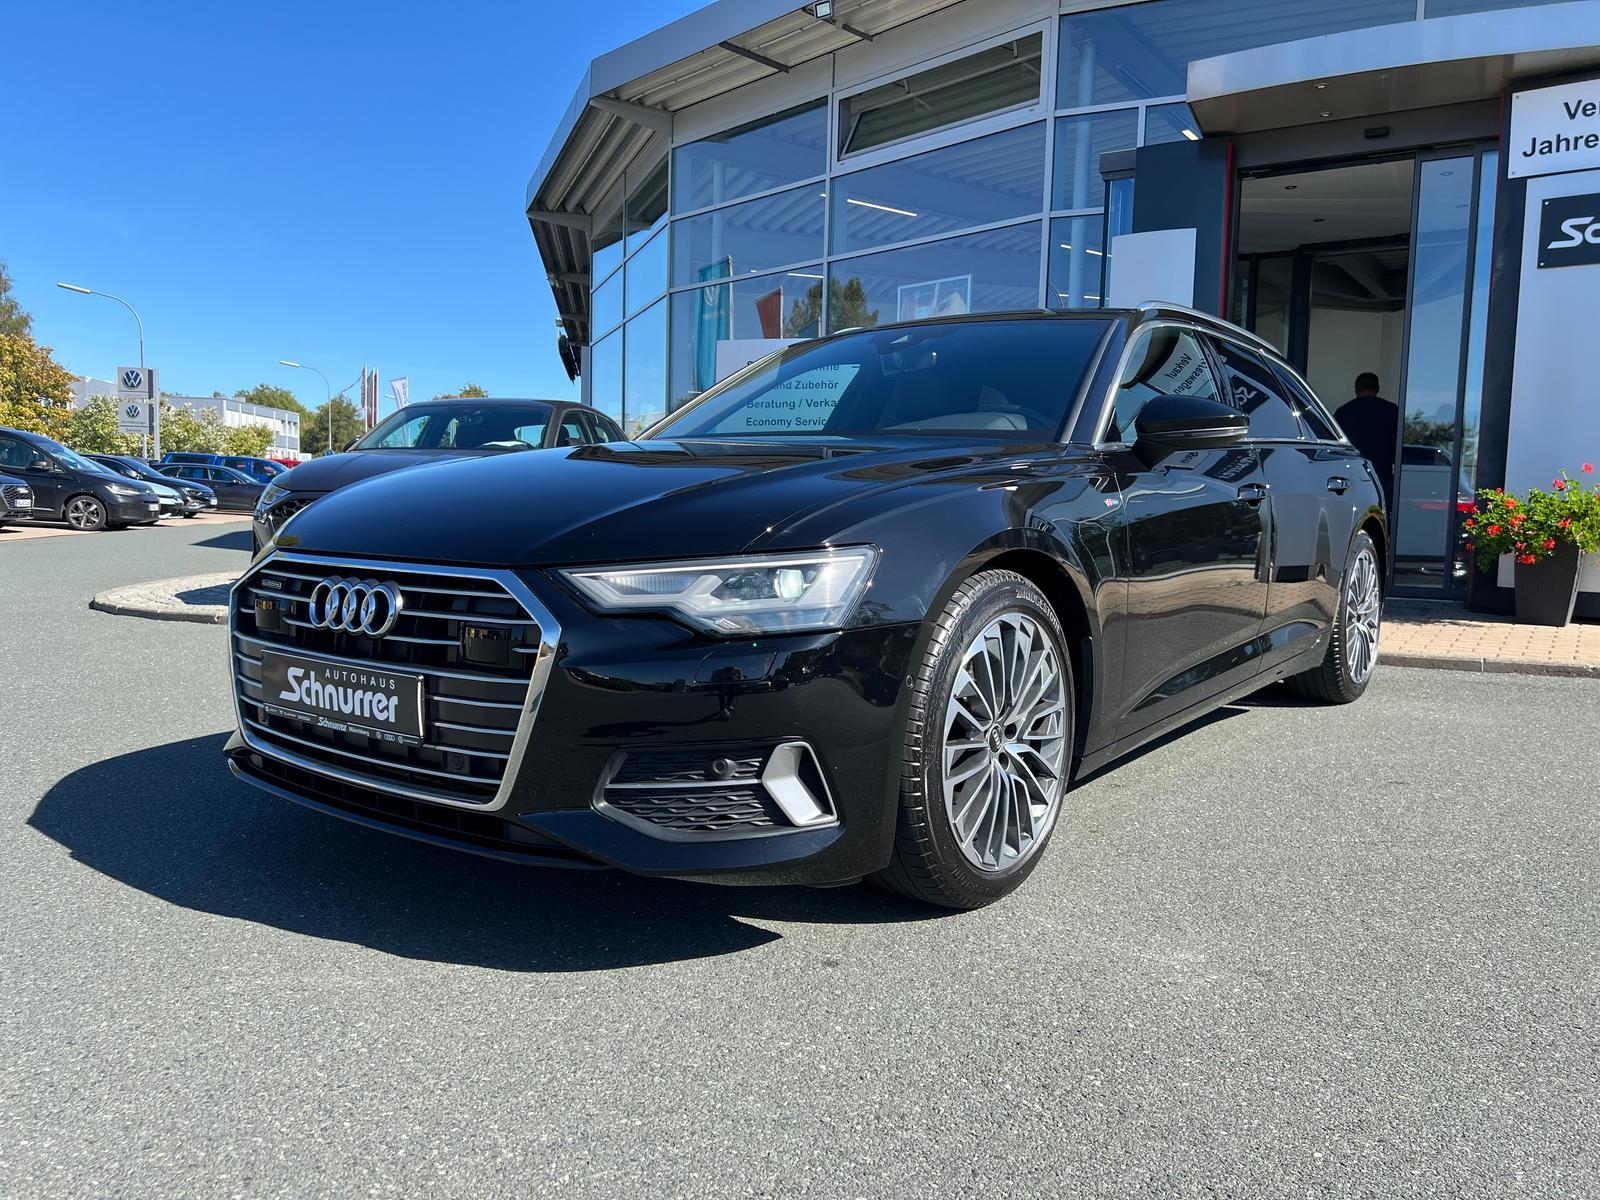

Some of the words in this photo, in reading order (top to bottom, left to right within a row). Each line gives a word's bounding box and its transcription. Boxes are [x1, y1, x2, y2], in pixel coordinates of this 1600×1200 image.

[1563, 99, 1600, 121] Ve
[1522, 133, 1599, 158] Jahre
[795, 380, 839, 390] Zubehör
[746, 417, 792, 429] Economy
[324, 668, 396, 690] AUTOHAUS
[279, 666, 399, 723] Schnurrer
